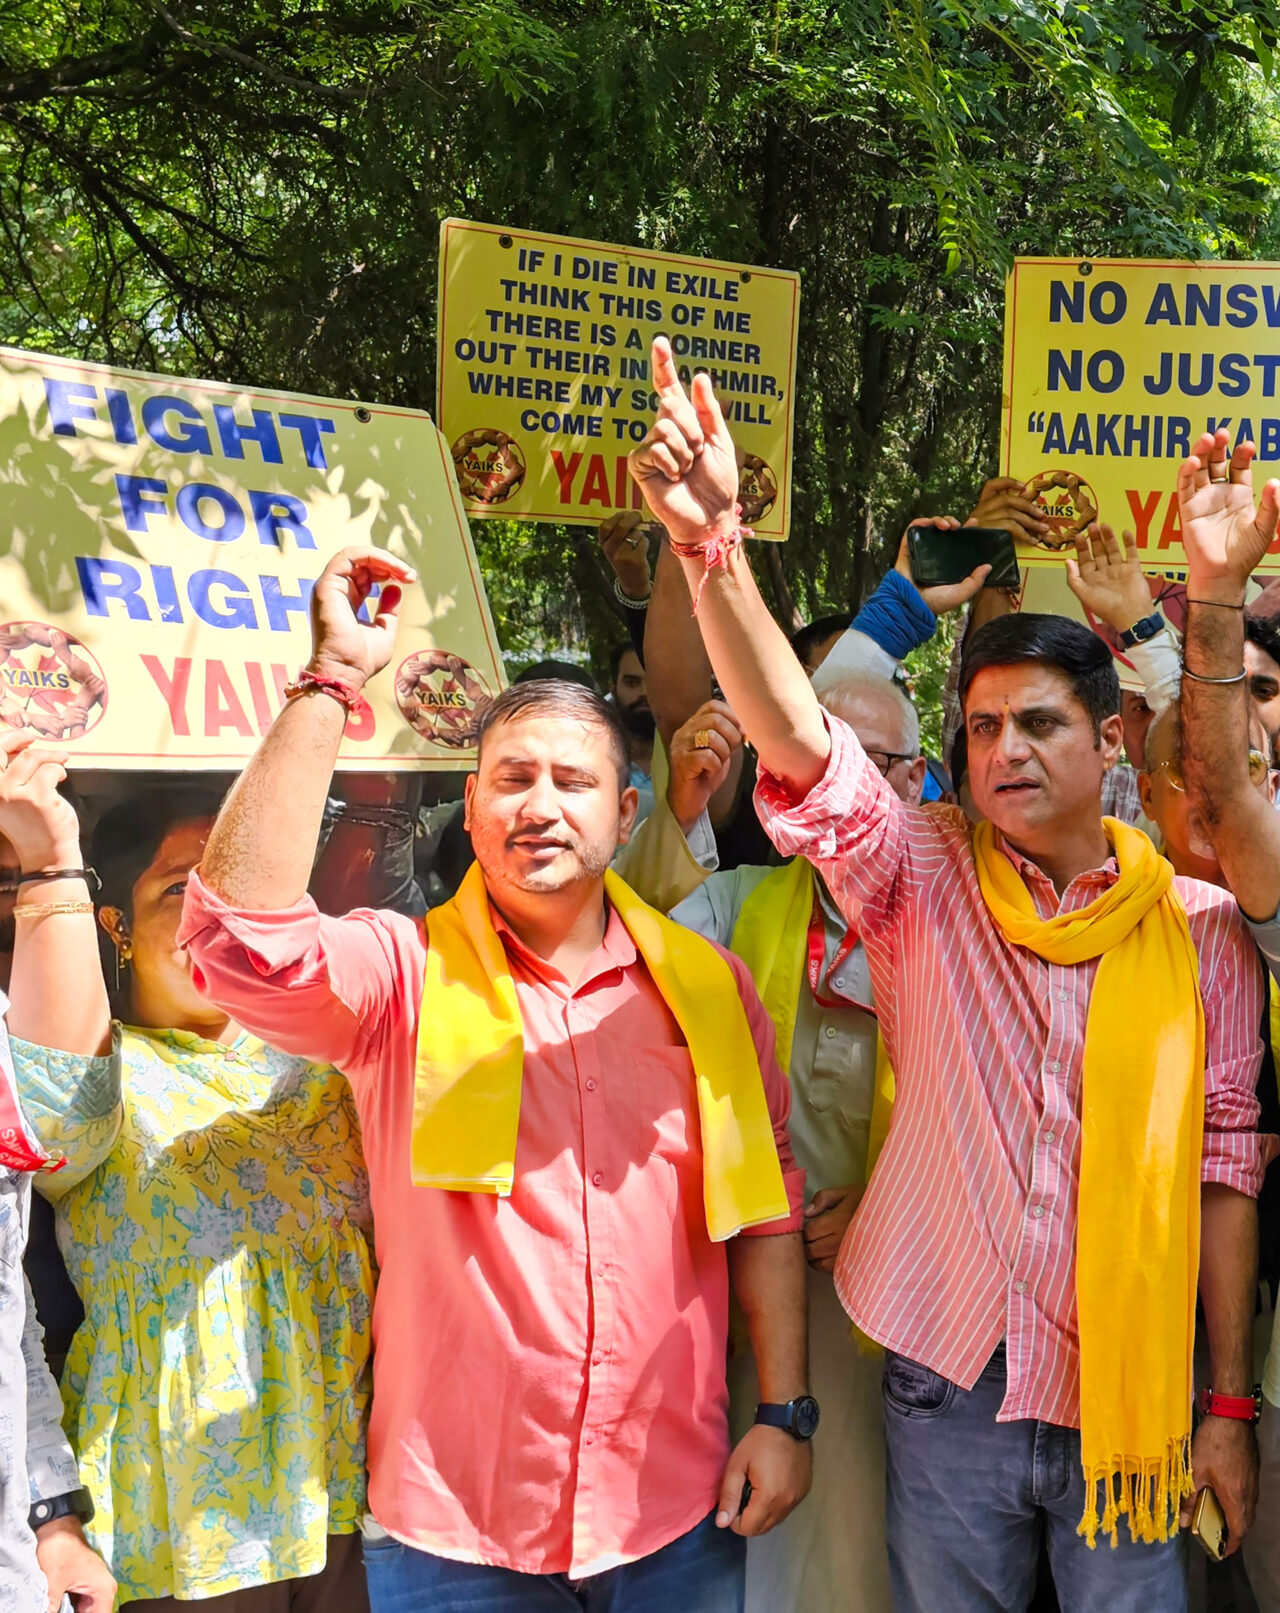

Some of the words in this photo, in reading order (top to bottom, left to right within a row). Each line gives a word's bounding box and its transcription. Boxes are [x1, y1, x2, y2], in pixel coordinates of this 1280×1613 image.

[518, 248, 544, 272] IF
[553, 254, 562, 276] I
[572, 257, 618, 284] DIE
[628, 265, 655, 290] IN
[666, 271, 740, 302] EXILE
[500, 279, 591, 312] THINK
[598, 293, 662, 322] THIS
[671, 304, 706, 327] OF
[713, 310, 751, 334] ME
[1048, 280, 1127, 325] NO
[485, 309, 581, 342] THERE
[591, 323, 617, 346] IS
[625, 328, 643, 350] A
[652, 331, 761, 365] ORNER
[455, 338, 517, 368] OUT
[525, 346, 611, 377] THEIR
[620, 357, 648, 381] IN
[1047, 349, 1125, 393] NO
[467, 371, 571, 404] WHERE
[581, 384, 622, 410] MY
[725, 400, 772, 426] ILL
[43, 376, 336, 470] FIGHT
[520, 409, 603, 438] COME
[612, 418, 648, 442] TO
[464, 460, 503, 472] YAIKS
[114, 473, 318, 550] FOR
[1039, 506, 1074, 517] AIKS
[3, 669, 70, 688] YAIKS
[415, 692, 467, 706] YAIKS
